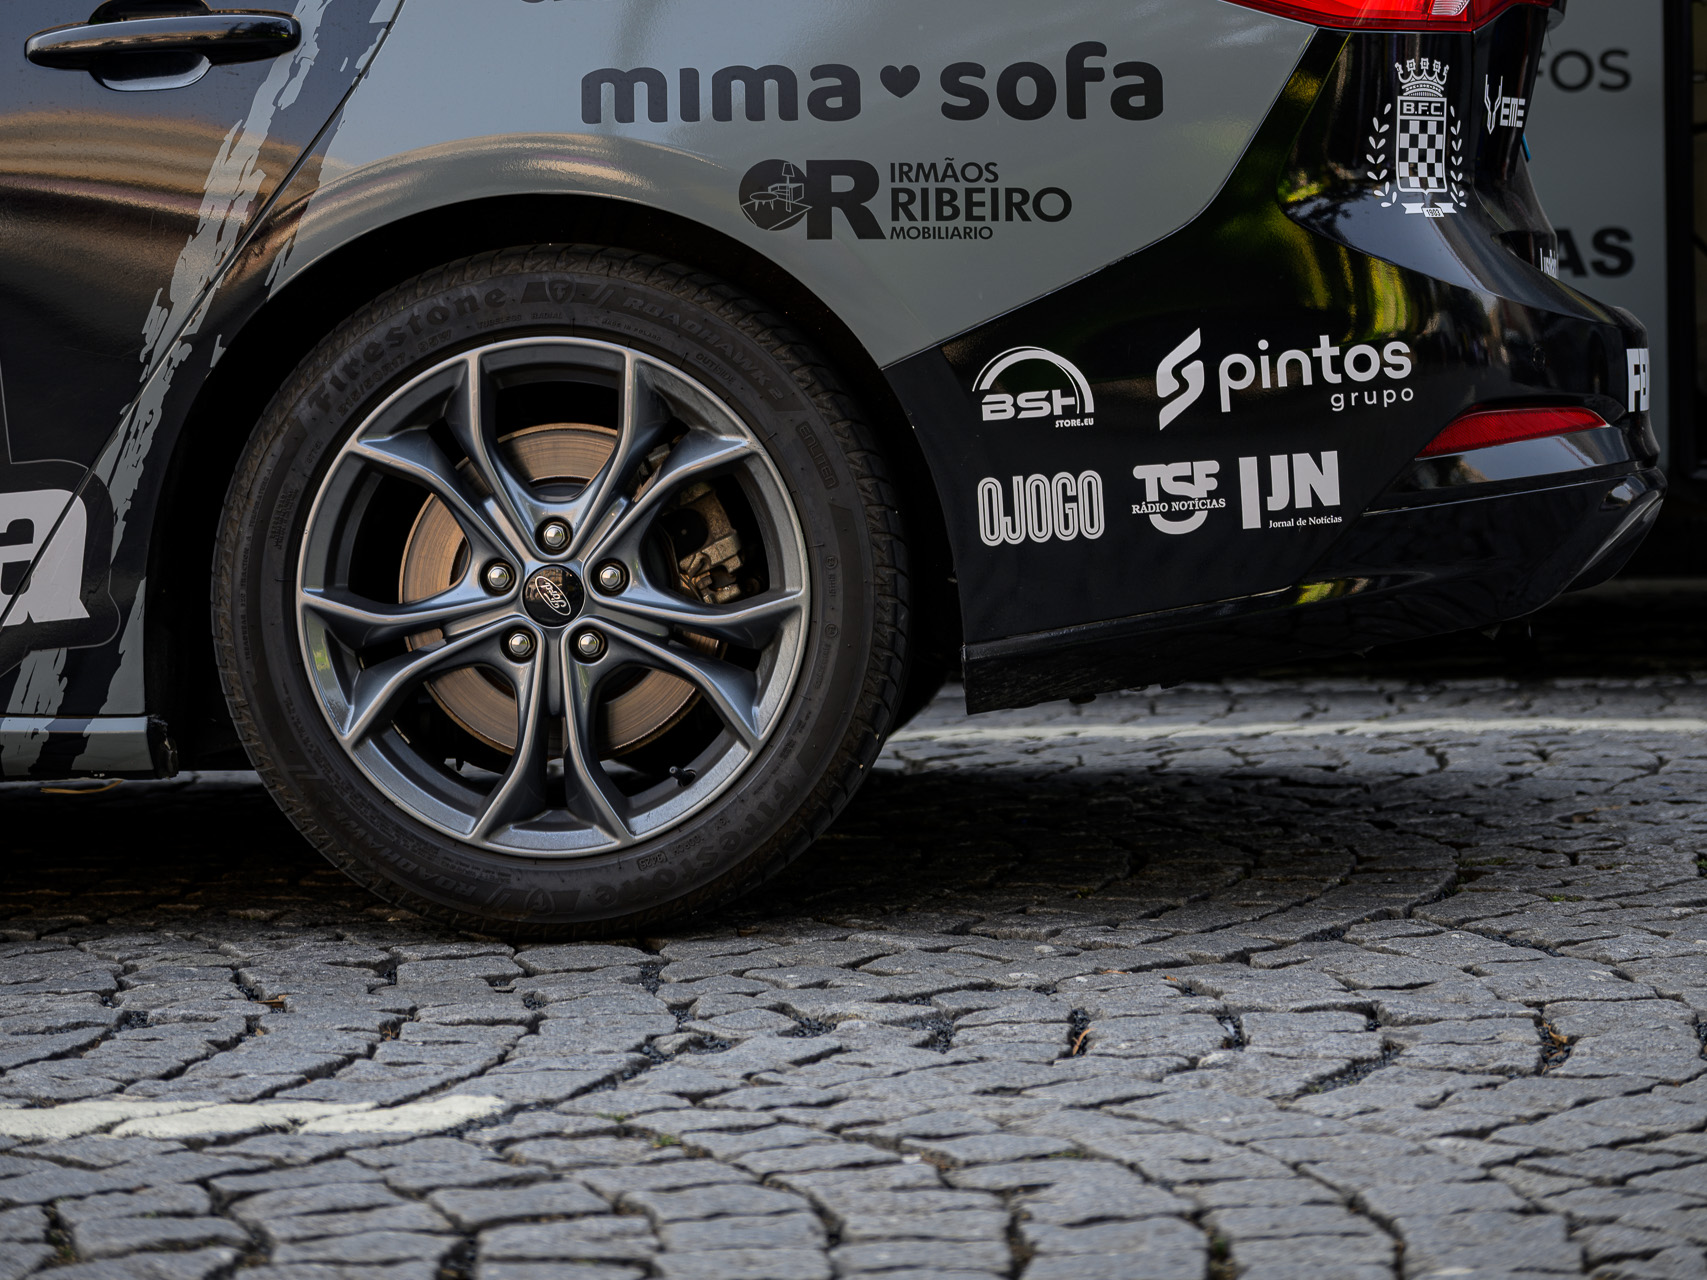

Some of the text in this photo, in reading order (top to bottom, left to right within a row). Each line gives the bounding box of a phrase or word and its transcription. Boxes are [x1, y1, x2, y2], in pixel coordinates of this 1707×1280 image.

[581, 41, 1164, 124] mima sofa
[1537, 48, 1633, 93] OS
[1402, 101, 1443, 115] B.F.C.
[890, 157, 998, 183] IRMÃOS
[890, 187, 1072, 222] RIBEIRO
[890, 226, 993, 240] MOBILIARIO
[622, 296, 772, 387] ROADHAWK
[1218, 335, 1412, 413] pintos
[981, 389, 1076, 421] BSH
[1330, 386, 1414, 411] grupo
[1055, 417, 1094, 428] STORE.EU
[1131, 498, 1226, 514] RÁDIO NOTÍCIAS
[1132, 460, 1220, 535] TSF
[1269, 514, 1342, 528] Jornal de Notícias
[541, 582, 567, 608] Ford
